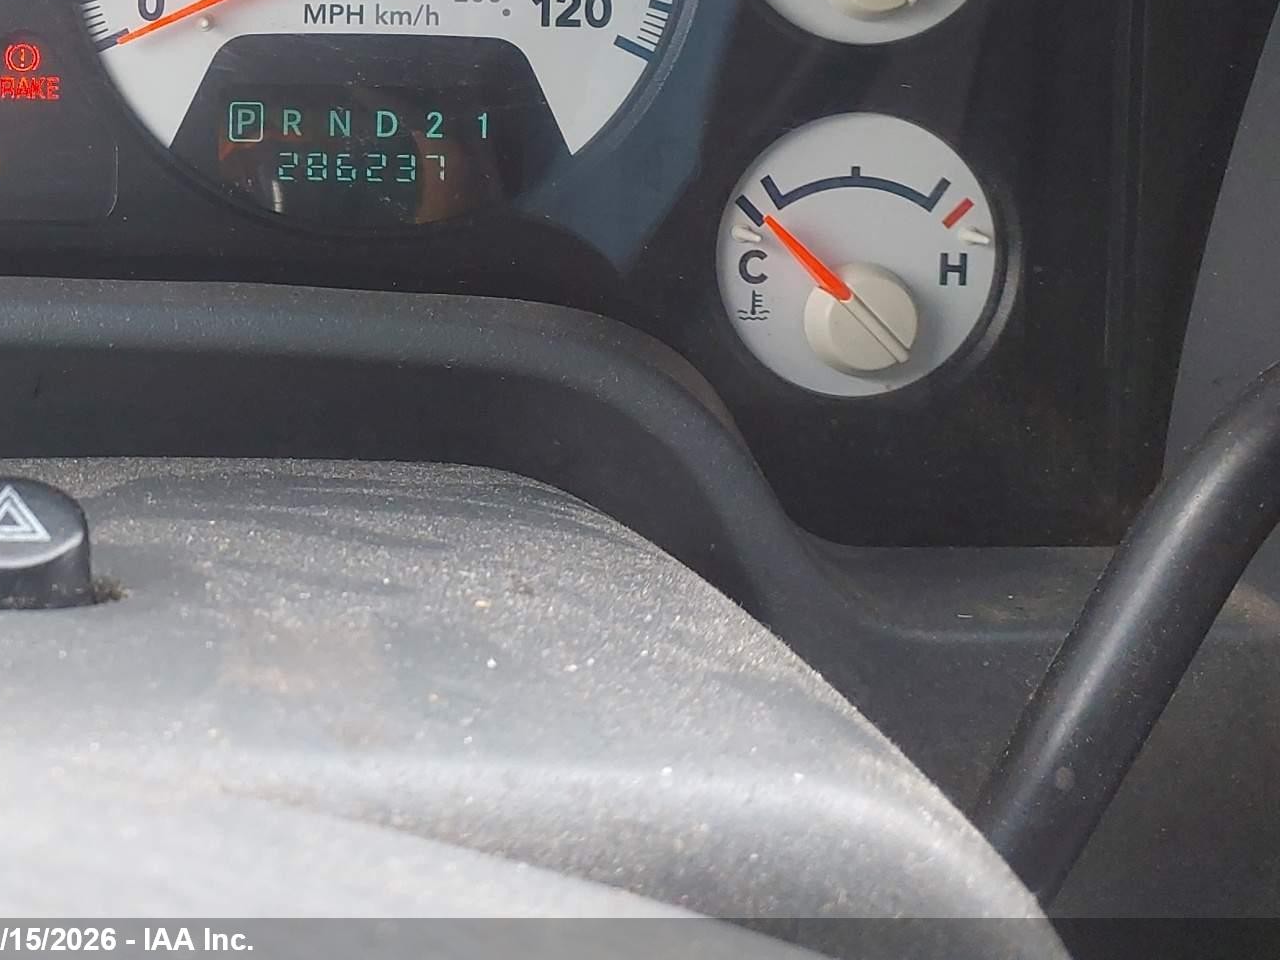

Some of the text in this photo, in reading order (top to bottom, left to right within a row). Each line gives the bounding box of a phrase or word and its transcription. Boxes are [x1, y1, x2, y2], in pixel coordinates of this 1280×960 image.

[305, 4, 438, 26] MPH km/h
[237, 109, 487, 138] P R N D 2 1
[279, 153, 444, 181] 286237
[739, 250, 767, 284] C
[940, 253, 967, 286] H
